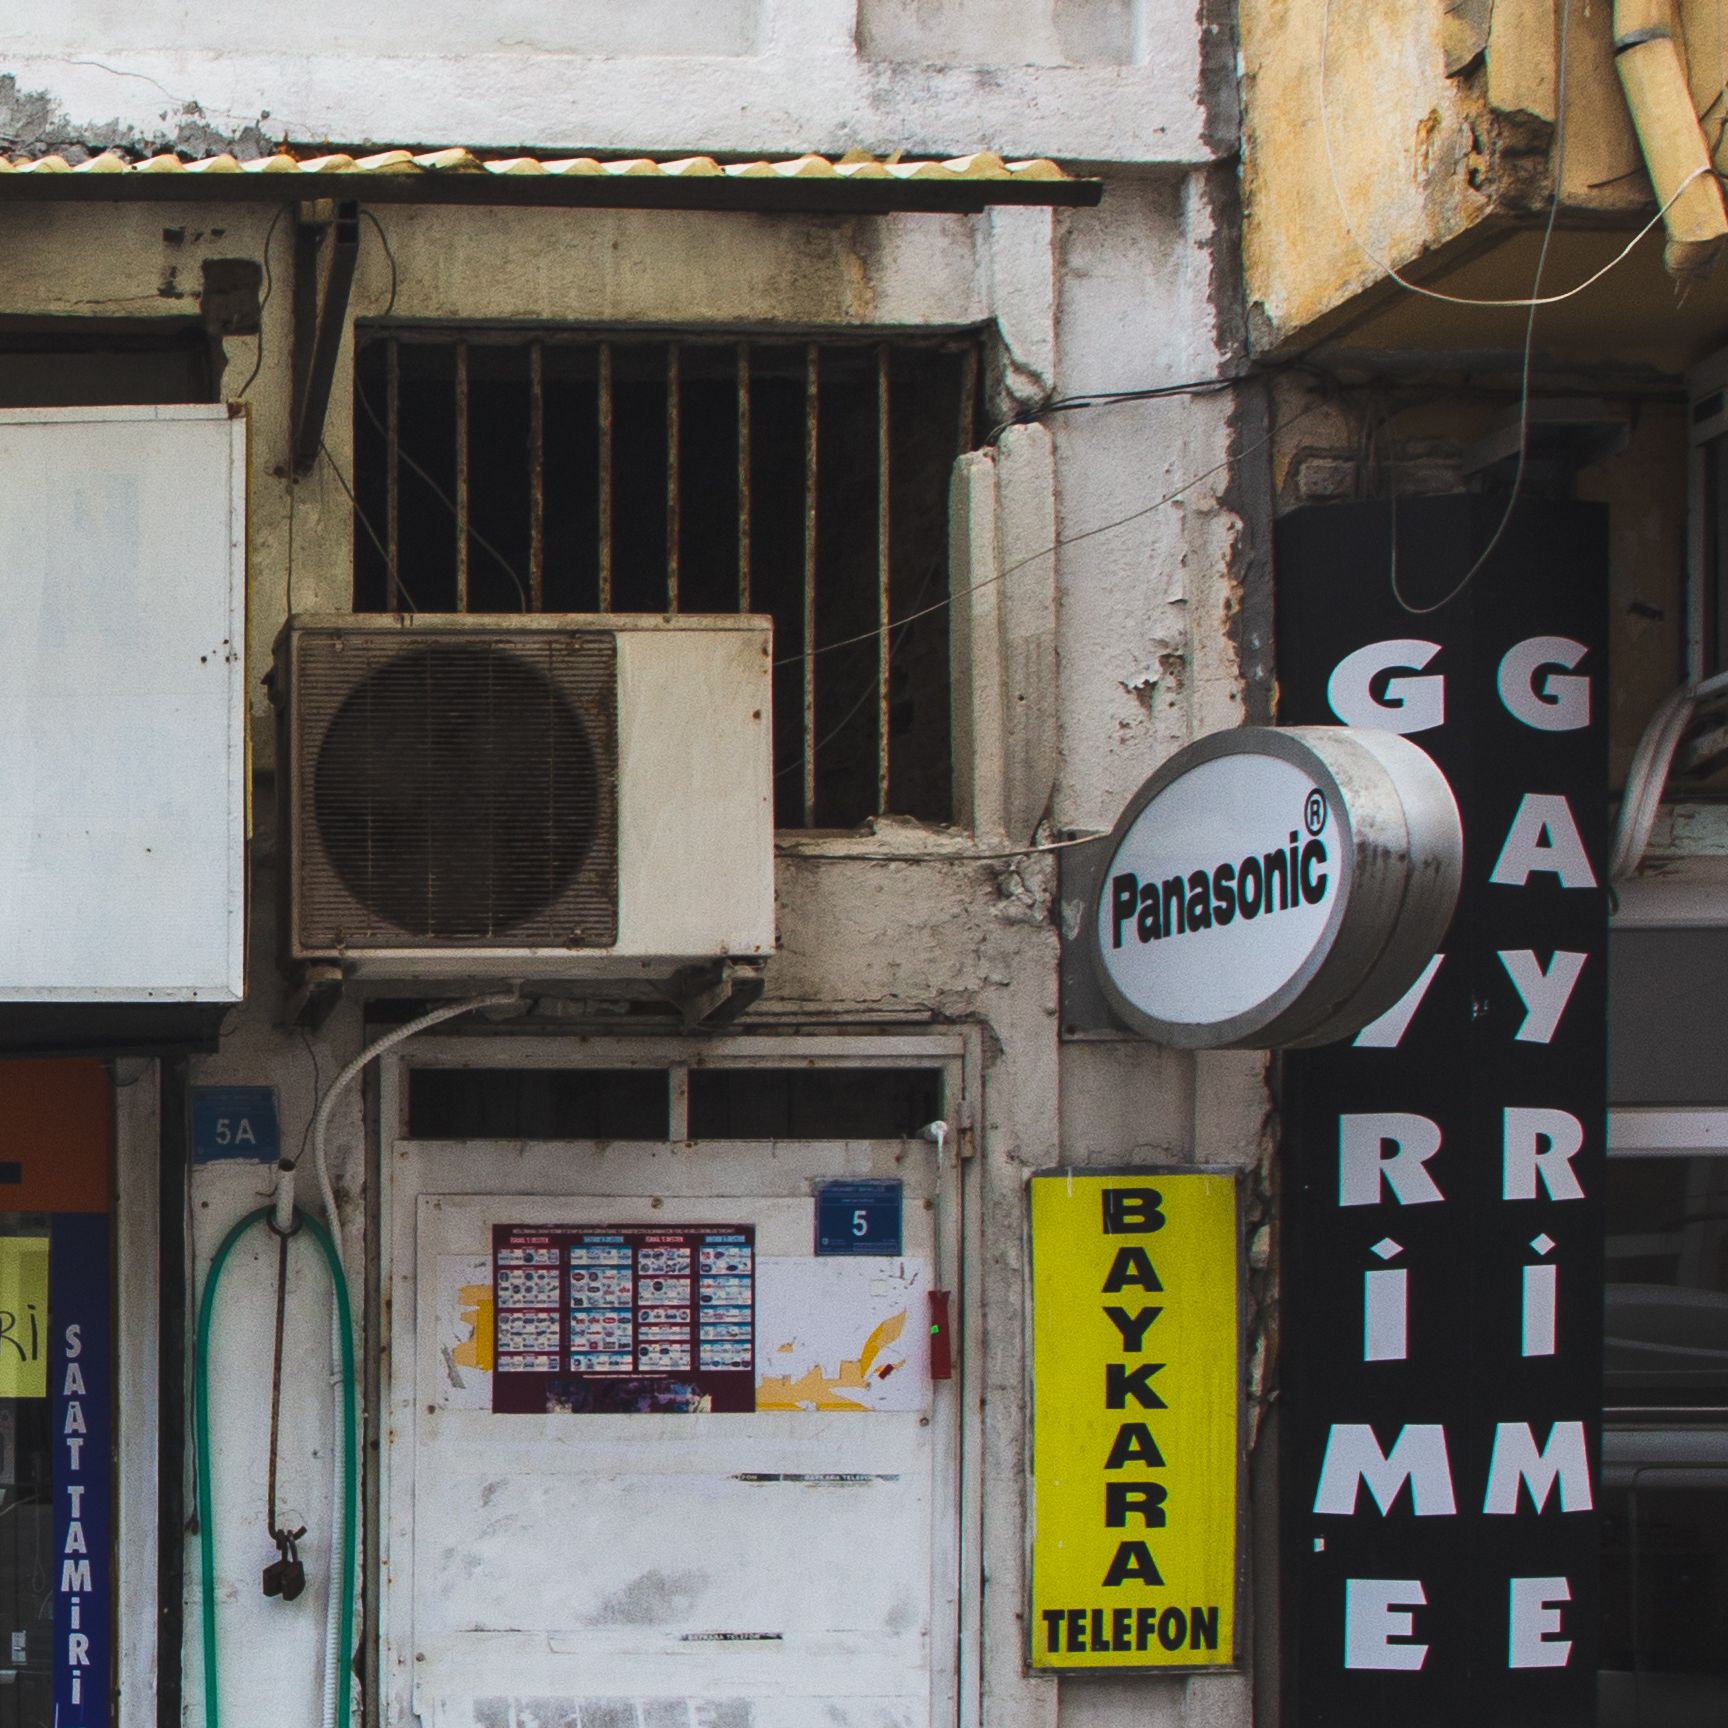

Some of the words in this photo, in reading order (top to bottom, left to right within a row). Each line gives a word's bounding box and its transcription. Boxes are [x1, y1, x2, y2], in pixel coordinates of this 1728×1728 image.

[1112, 829, 1329, 949] Panasonic
[852, 1210, 868, 1237] 5
[63, 1324, 87, 1470] SAAT
[1101, 1187, 1169, 1587] BAYKARA
[1043, 1606, 1219, 1652] TELEFON
